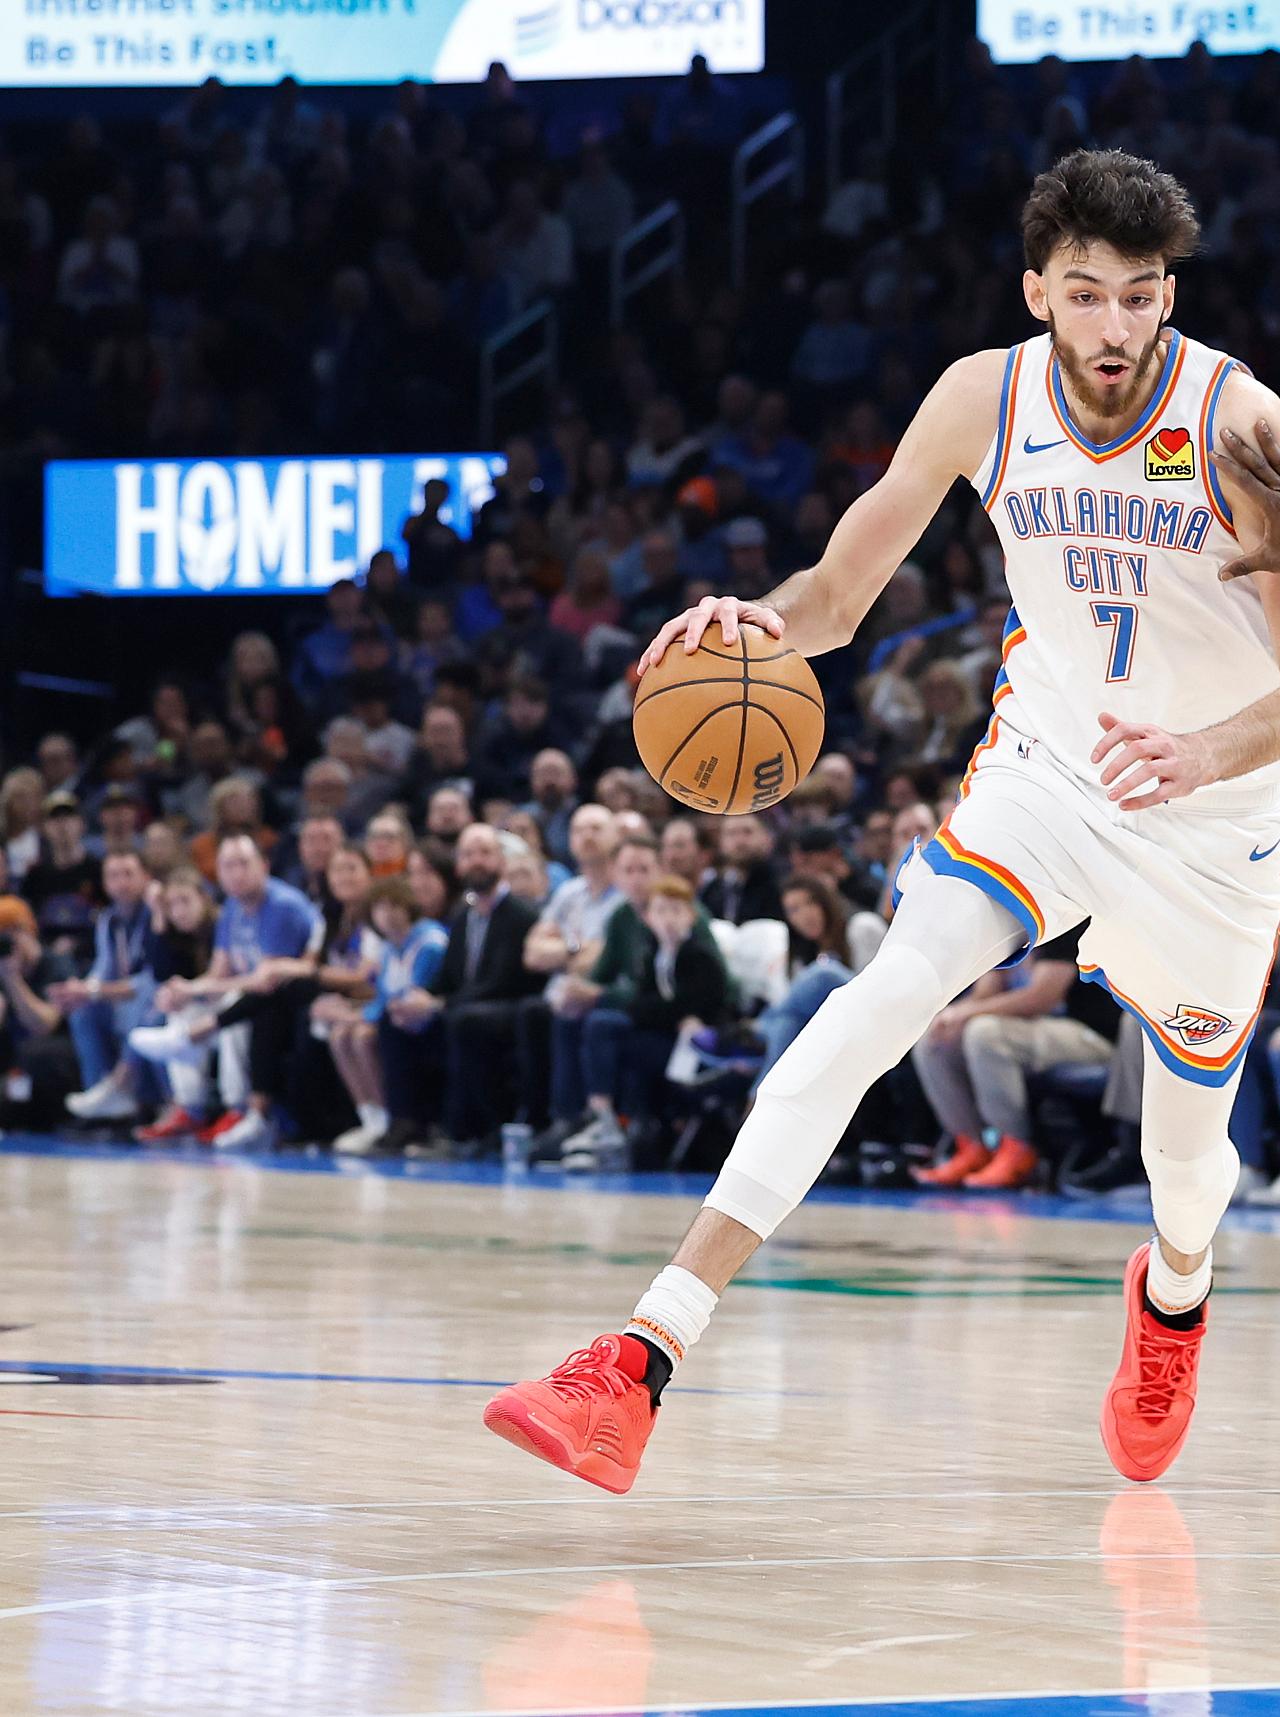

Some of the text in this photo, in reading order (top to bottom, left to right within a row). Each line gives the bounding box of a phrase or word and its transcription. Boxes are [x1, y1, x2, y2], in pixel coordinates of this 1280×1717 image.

[1004, 487, 1213, 554] OKLAHOMA
[1063, 545, 1148, 596] CITY
[1089, 601, 1139, 683] 7
